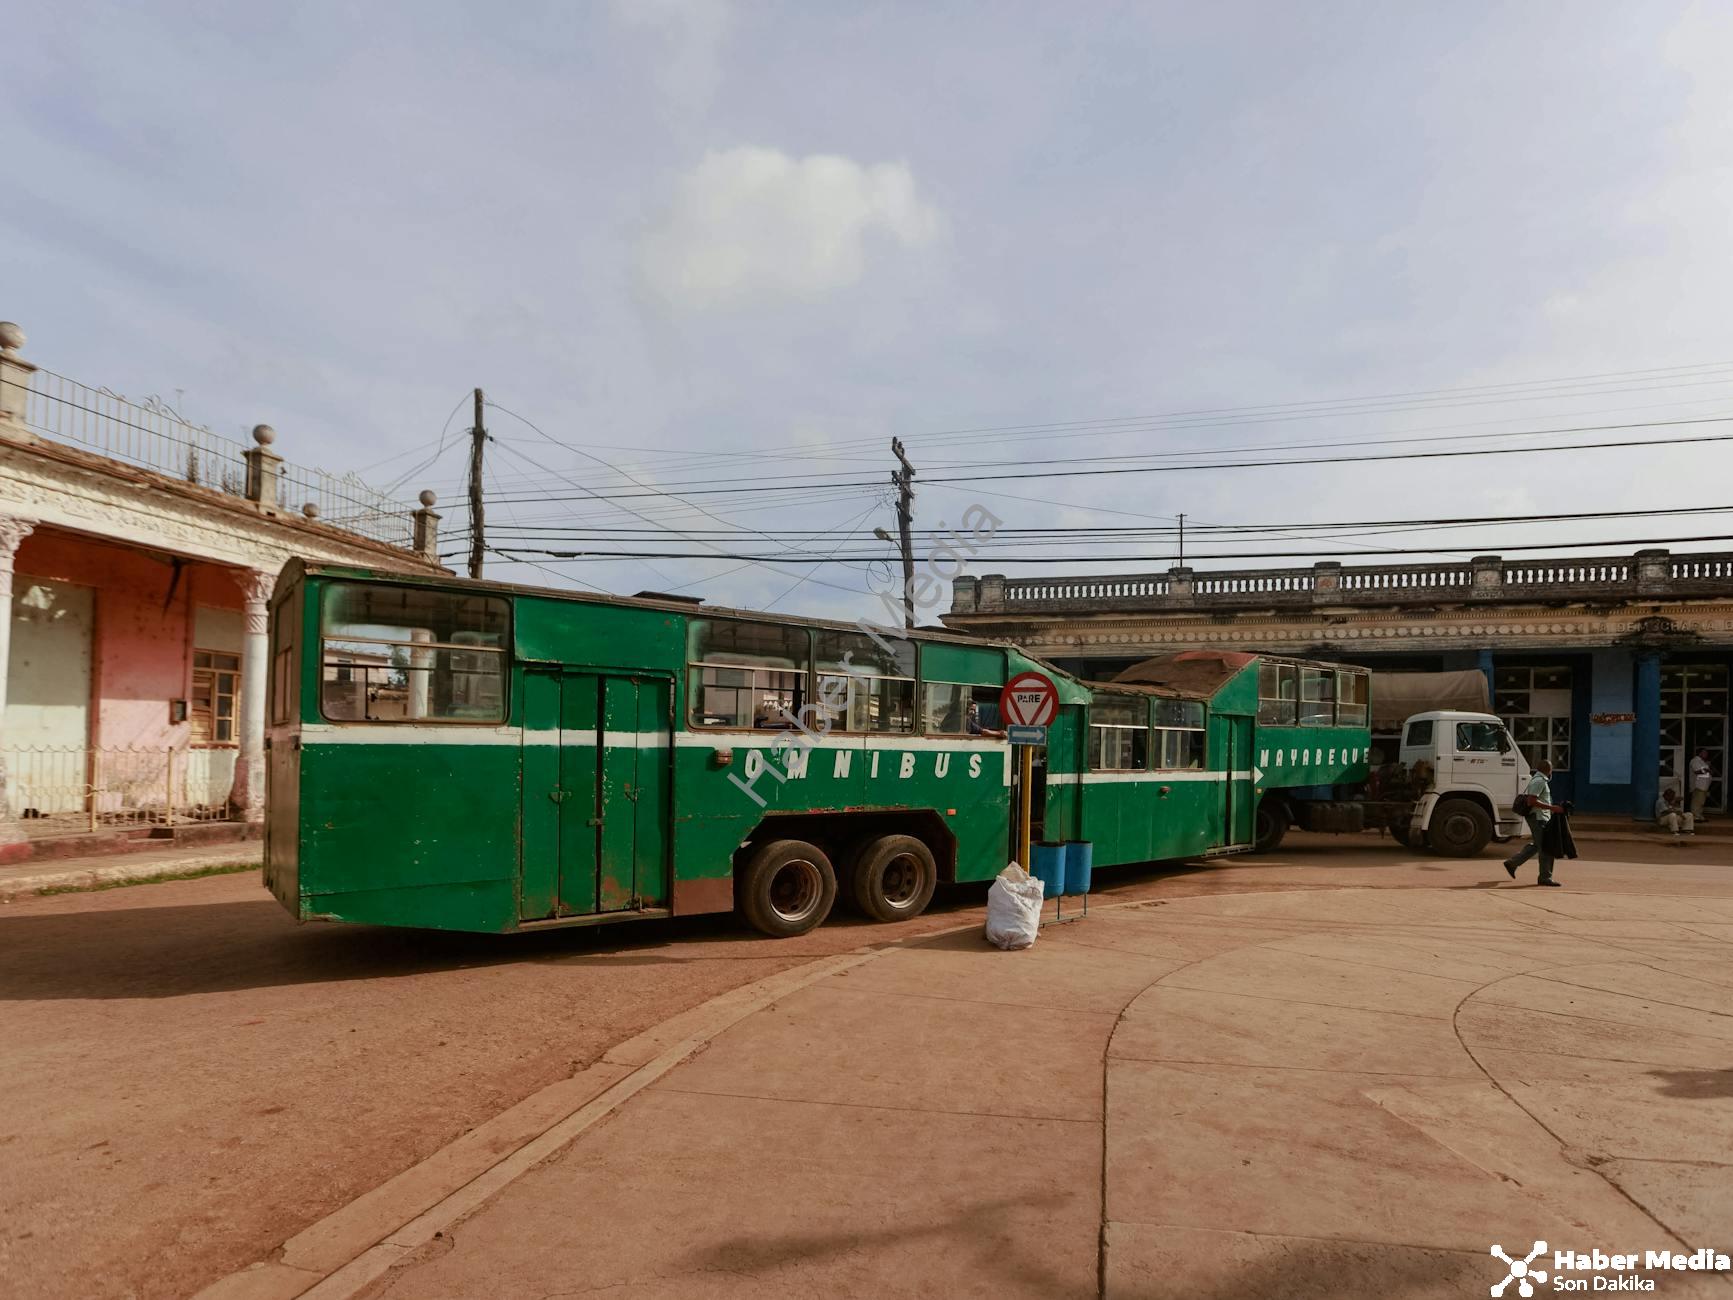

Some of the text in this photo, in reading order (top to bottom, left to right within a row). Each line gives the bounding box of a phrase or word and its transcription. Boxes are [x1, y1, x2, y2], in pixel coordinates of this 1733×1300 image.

[1017, 694, 1041, 703] PARE
[745, 748, 983, 779] OMNIBUS
[1259, 747, 1370, 768] MAYABEQUE
